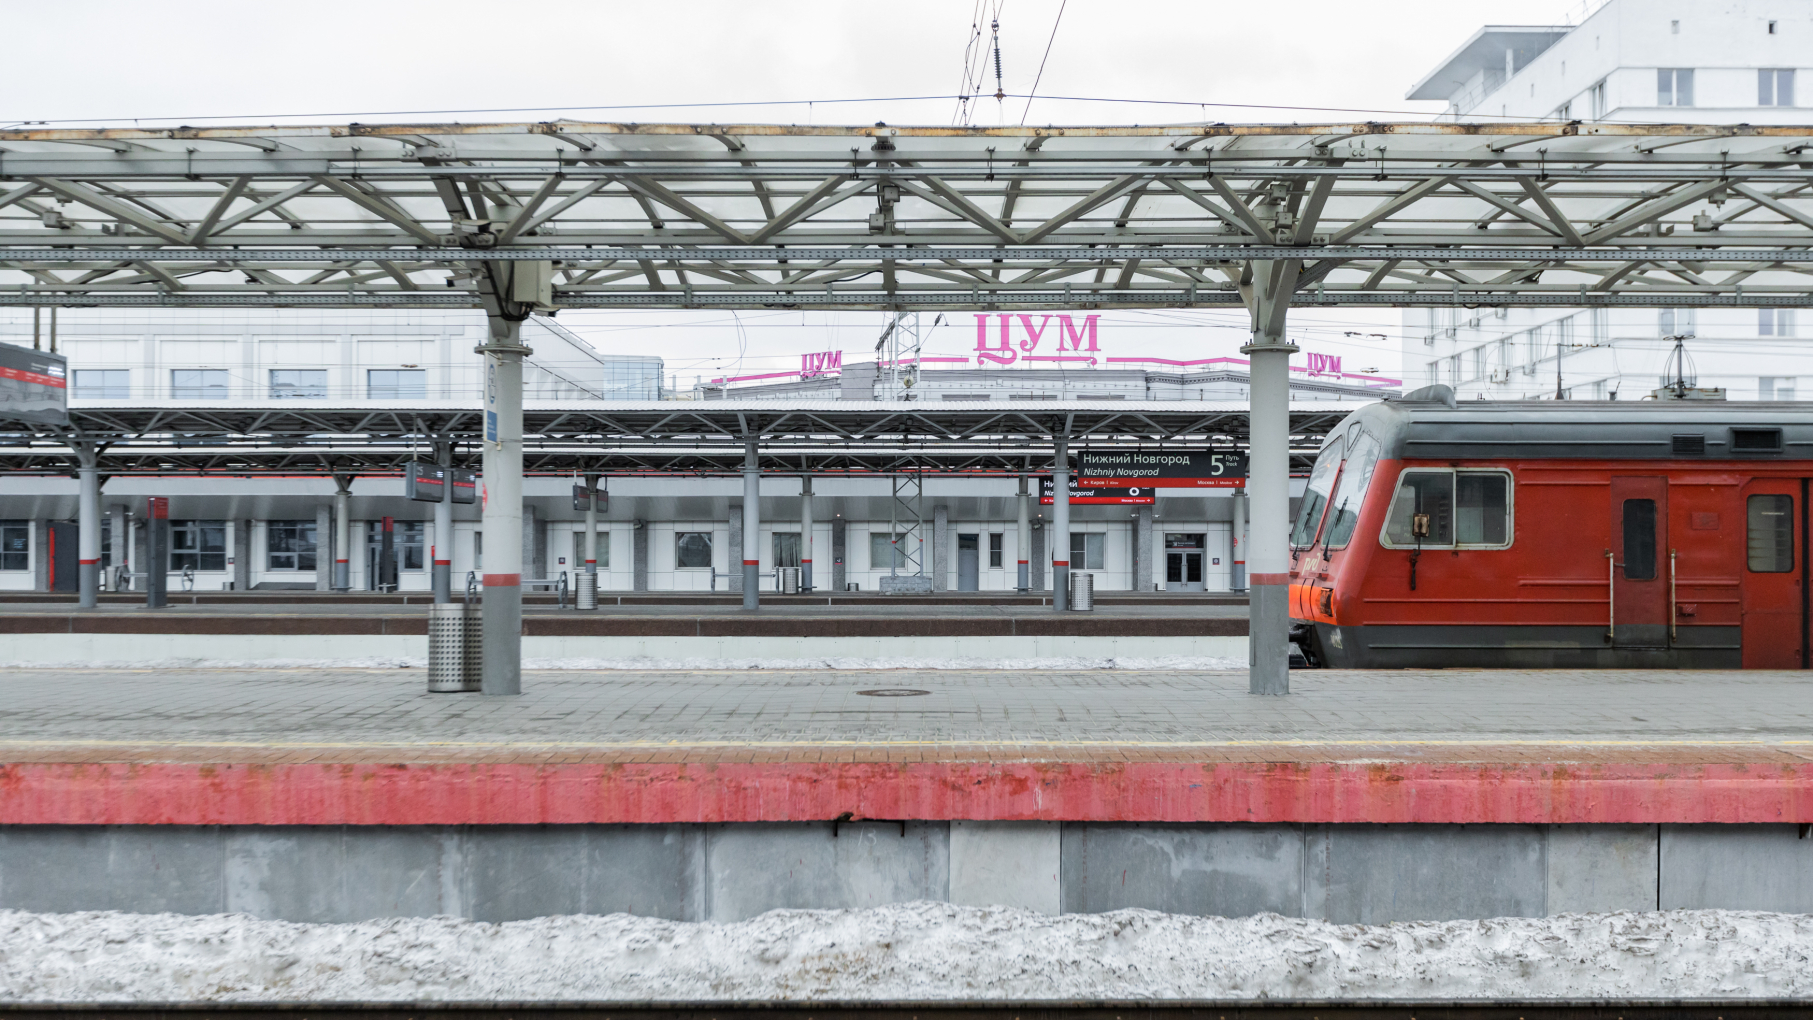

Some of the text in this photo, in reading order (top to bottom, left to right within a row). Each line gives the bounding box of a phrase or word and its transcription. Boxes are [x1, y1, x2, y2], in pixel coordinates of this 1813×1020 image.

[973, 314, 1102, 365] ЦУМ
[801, 350, 842, 378] ЦУМ
[1307, 352, 1342, 379] ЦУМ
[1083, 453, 1190, 466] Нижний Новгород
[1211, 454, 1224, 476] 5
[1225, 454, 1240, 462] Путь
[1084, 467, 1160, 478] Nizhniy Novgorod
[858, 825, 877, 846] 13
